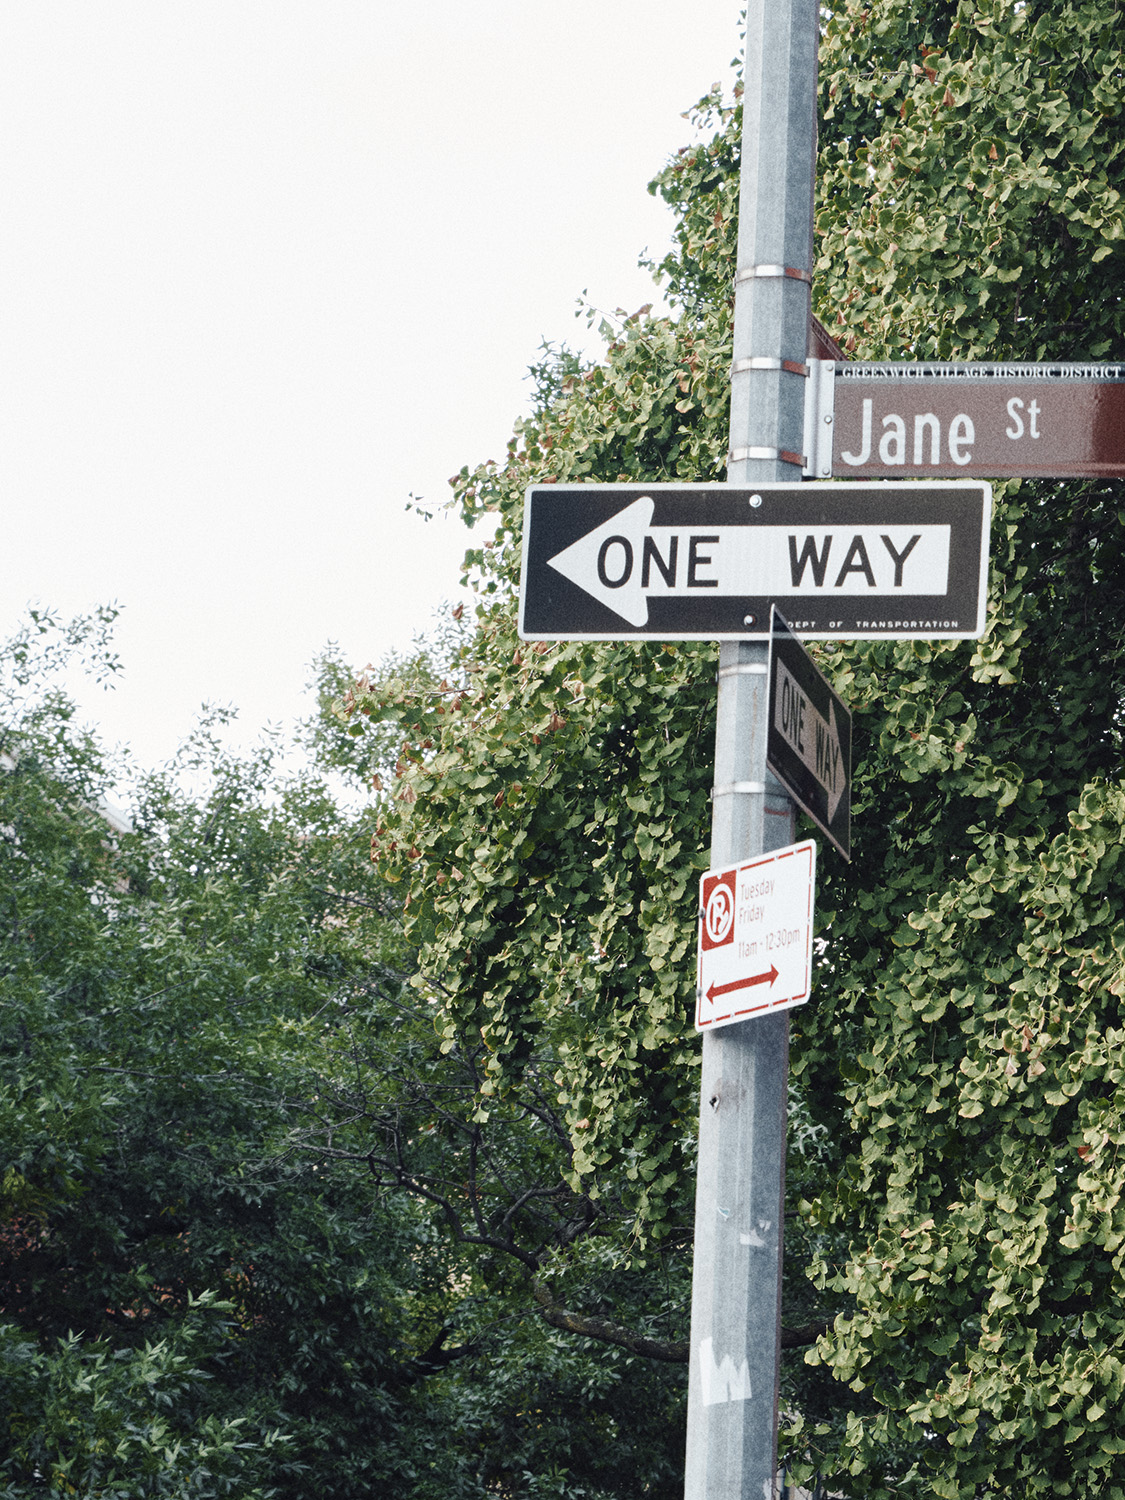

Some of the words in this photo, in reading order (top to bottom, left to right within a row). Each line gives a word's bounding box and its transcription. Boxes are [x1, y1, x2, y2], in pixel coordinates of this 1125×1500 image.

[841, 365, 925, 379] GREENWICH
[929, 365, 987, 379] VILLAGE
[992, 365, 1055, 379] HISTORIC
[1060, 365, 1122, 379] DISTRICT
[841, 398, 975, 466] Jane
[1005, 397, 1041, 440] St
[596, 534, 720, 590] ONE
[787, 534, 922, 588] WAY
[787, 620, 816, 629] DEPT
[829, 620, 844, 629] OF
[856, 620, 959, 629] TRANSPORTATION
[781, 675, 806, 756] ONE
[815, 718, 840, 795] WAY
[740, 878, 775, 901] Tuesday
[738, 904, 765, 924] Friday
[738, 941, 758, 958] 11am
[765, 928, 801, 951] 12:30pm
